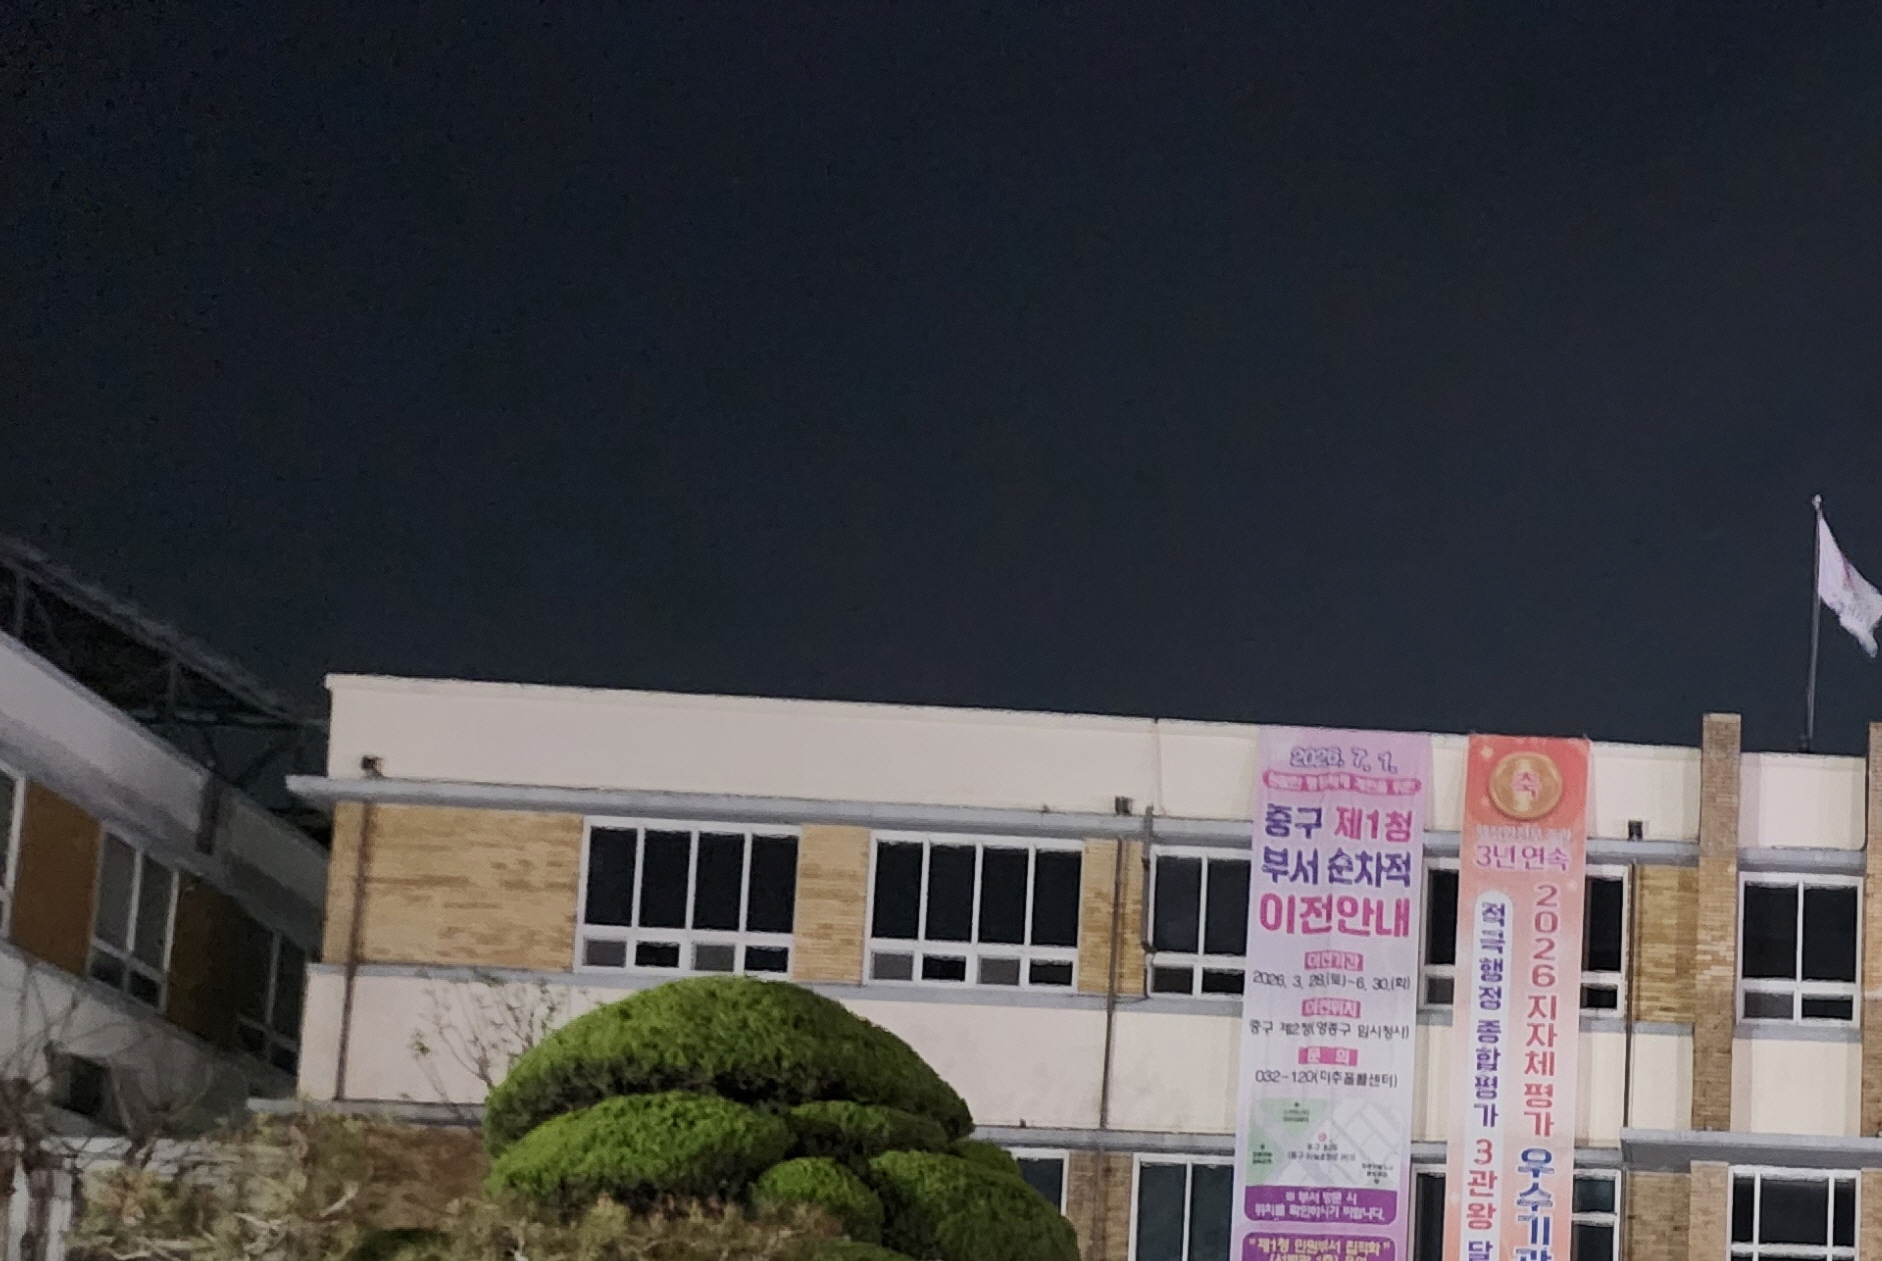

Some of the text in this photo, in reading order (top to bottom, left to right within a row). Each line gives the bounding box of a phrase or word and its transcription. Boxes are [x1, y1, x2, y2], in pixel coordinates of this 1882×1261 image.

[1290, 746, 1397, 774] 2026. 7. 1.
[1512, 771, 1541, 799] 축
[1265, 803, 1412, 843] 중구 제1청
[1261, 846, 1411, 888] 부서 순차적
[1259, 892, 1410, 937] 이전안내
[1532, 884, 1558, 987] 2026
[1479, 901, 1505, 1010] 적극행정
[1250, 1019, 1273, 1035] 중구
[1524, 995, 1557, 1076] 지자체
[1473, 1019, 1502, 1127] 종합평가
[1524, 1084, 1554, 1137] 평가
[1466, 1138, 1498, 1230] 3관왕
